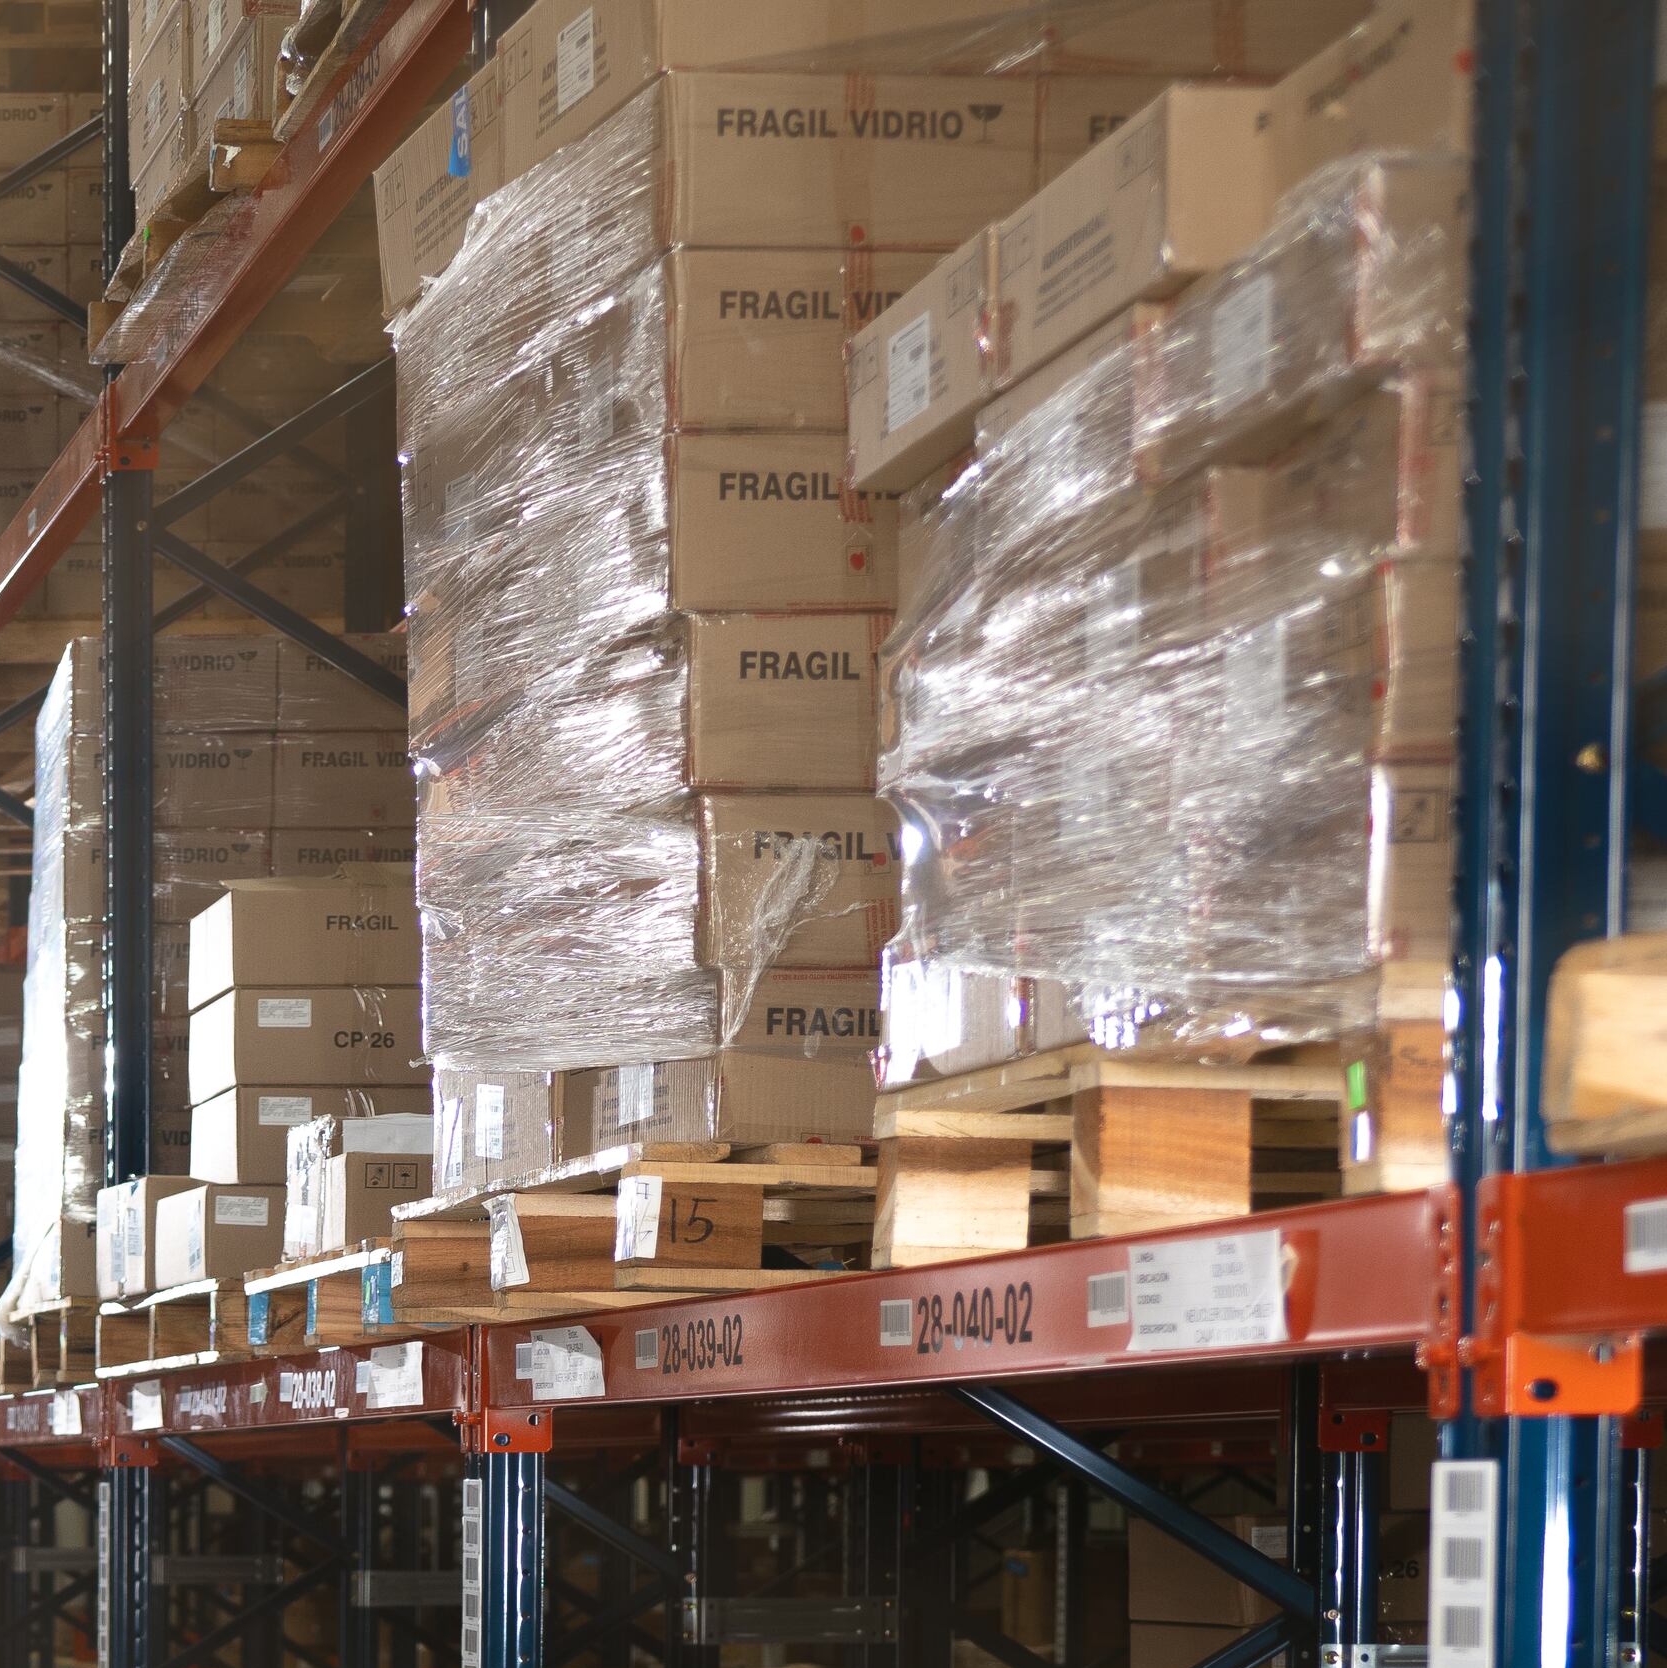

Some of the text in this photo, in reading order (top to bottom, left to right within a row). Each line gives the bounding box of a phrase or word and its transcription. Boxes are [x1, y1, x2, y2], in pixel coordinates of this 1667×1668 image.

[717, 108, 963, 140] FRAGIL VIDRIO
[719, 290, 840, 320] FRAGIL
[719, 472, 840, 501] FRAGIL
[739, 650, 860, 681] FRAGIL
[169, 752, 231, 769] VIDRIO
[301, 752, 369, 768] FRAGIL
[326, 915, 399, 931] FRAGIL
[333, 1031, 395, 1049] CP 26
[669, 1197, 718, 1244] 15
[917, 1281, 1034, 1355] 28-040-02
[662, 1313, 744, 1375] 28-039-02
